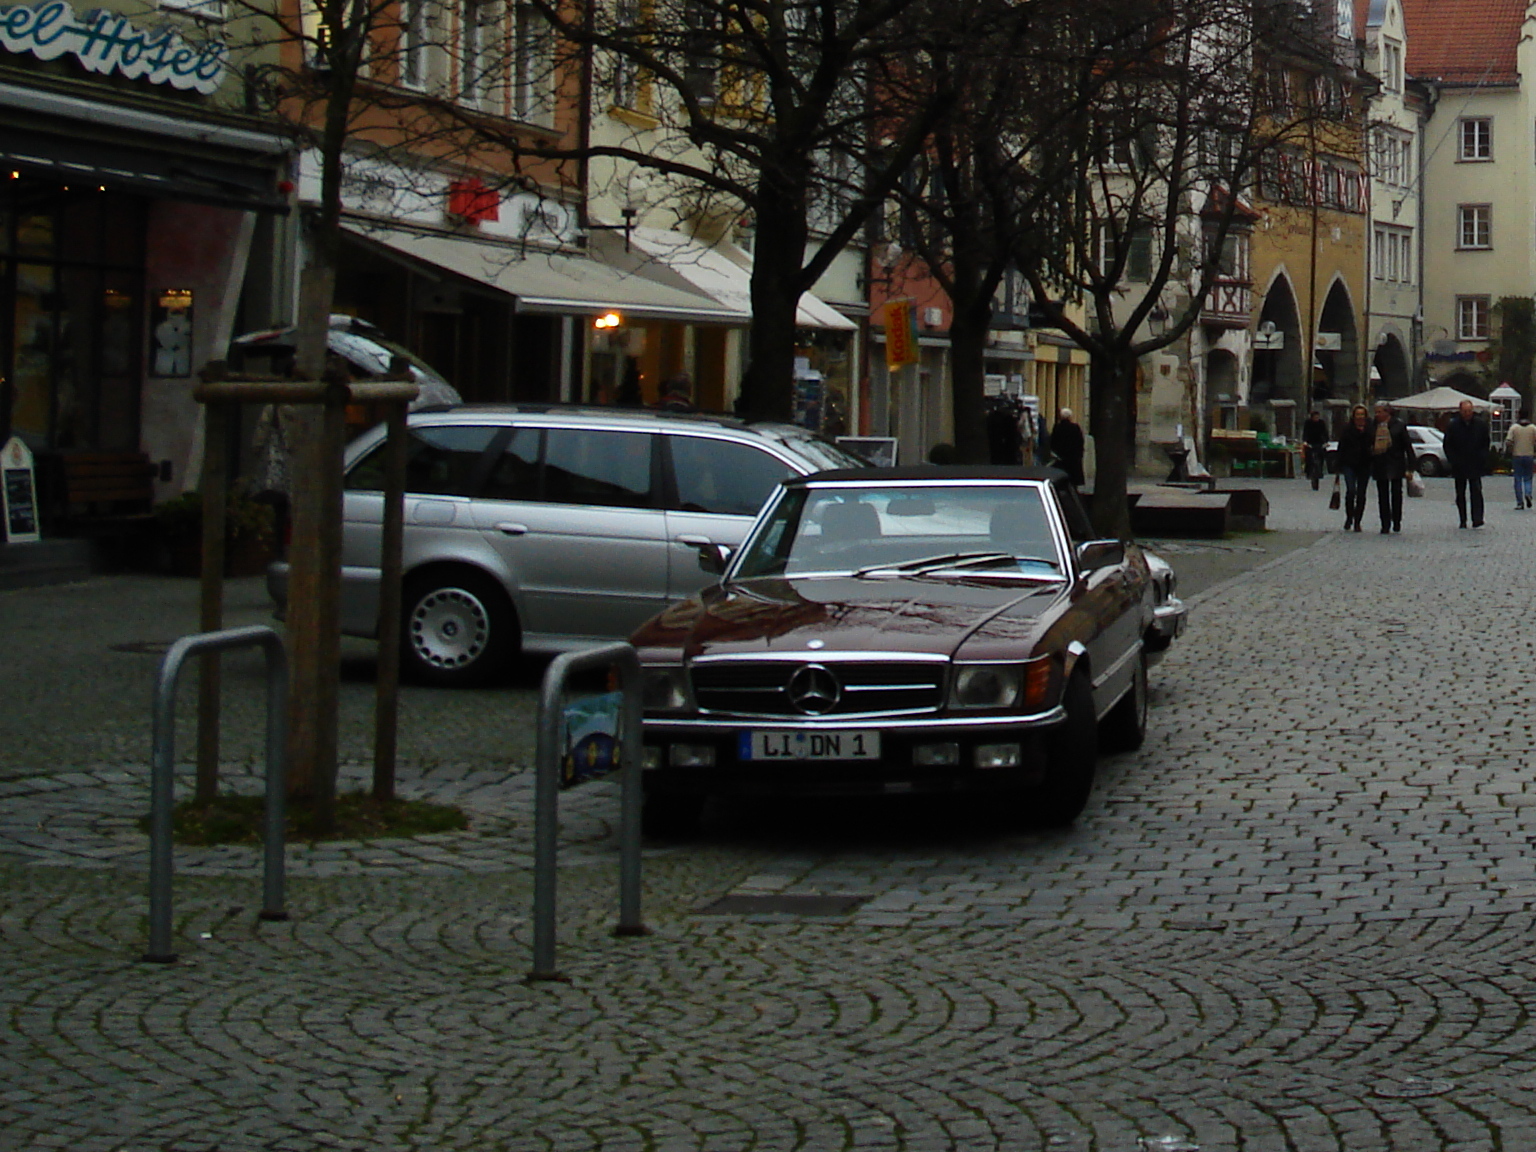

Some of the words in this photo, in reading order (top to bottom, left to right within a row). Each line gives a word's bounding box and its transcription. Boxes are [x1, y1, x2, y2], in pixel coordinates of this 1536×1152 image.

[763, 734, 792, 757] LI
[809, 734, 841, 757] DN
[852, 734, 867, 756] 1
